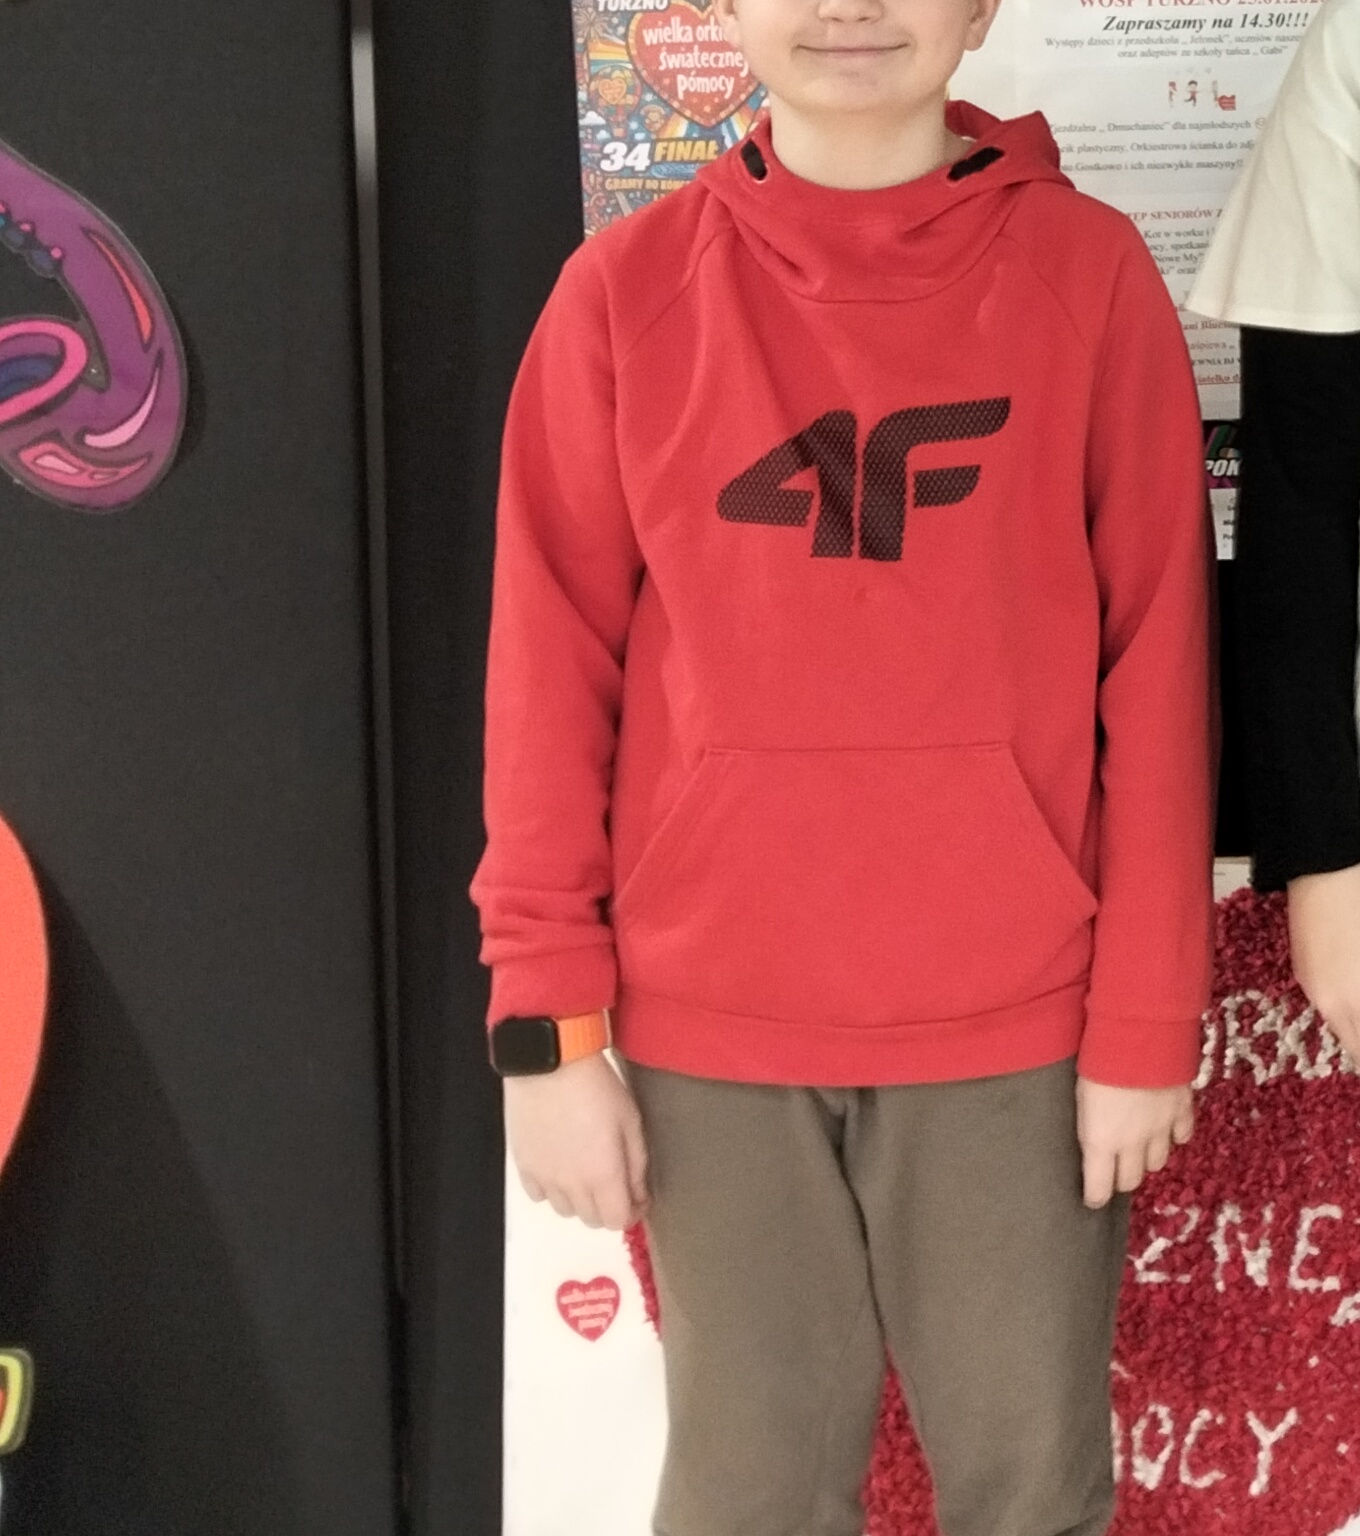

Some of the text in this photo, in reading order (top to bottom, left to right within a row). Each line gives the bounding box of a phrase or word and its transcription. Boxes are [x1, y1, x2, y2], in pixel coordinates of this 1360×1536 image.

[643, 16, 694, 46] wielka
[1102, 12, 1309, 35] Zapraszamy na 14.30!!!
[600, 140, 719, 172] 34 FINAŁ
[716, 396, 1011, 561] 4F
